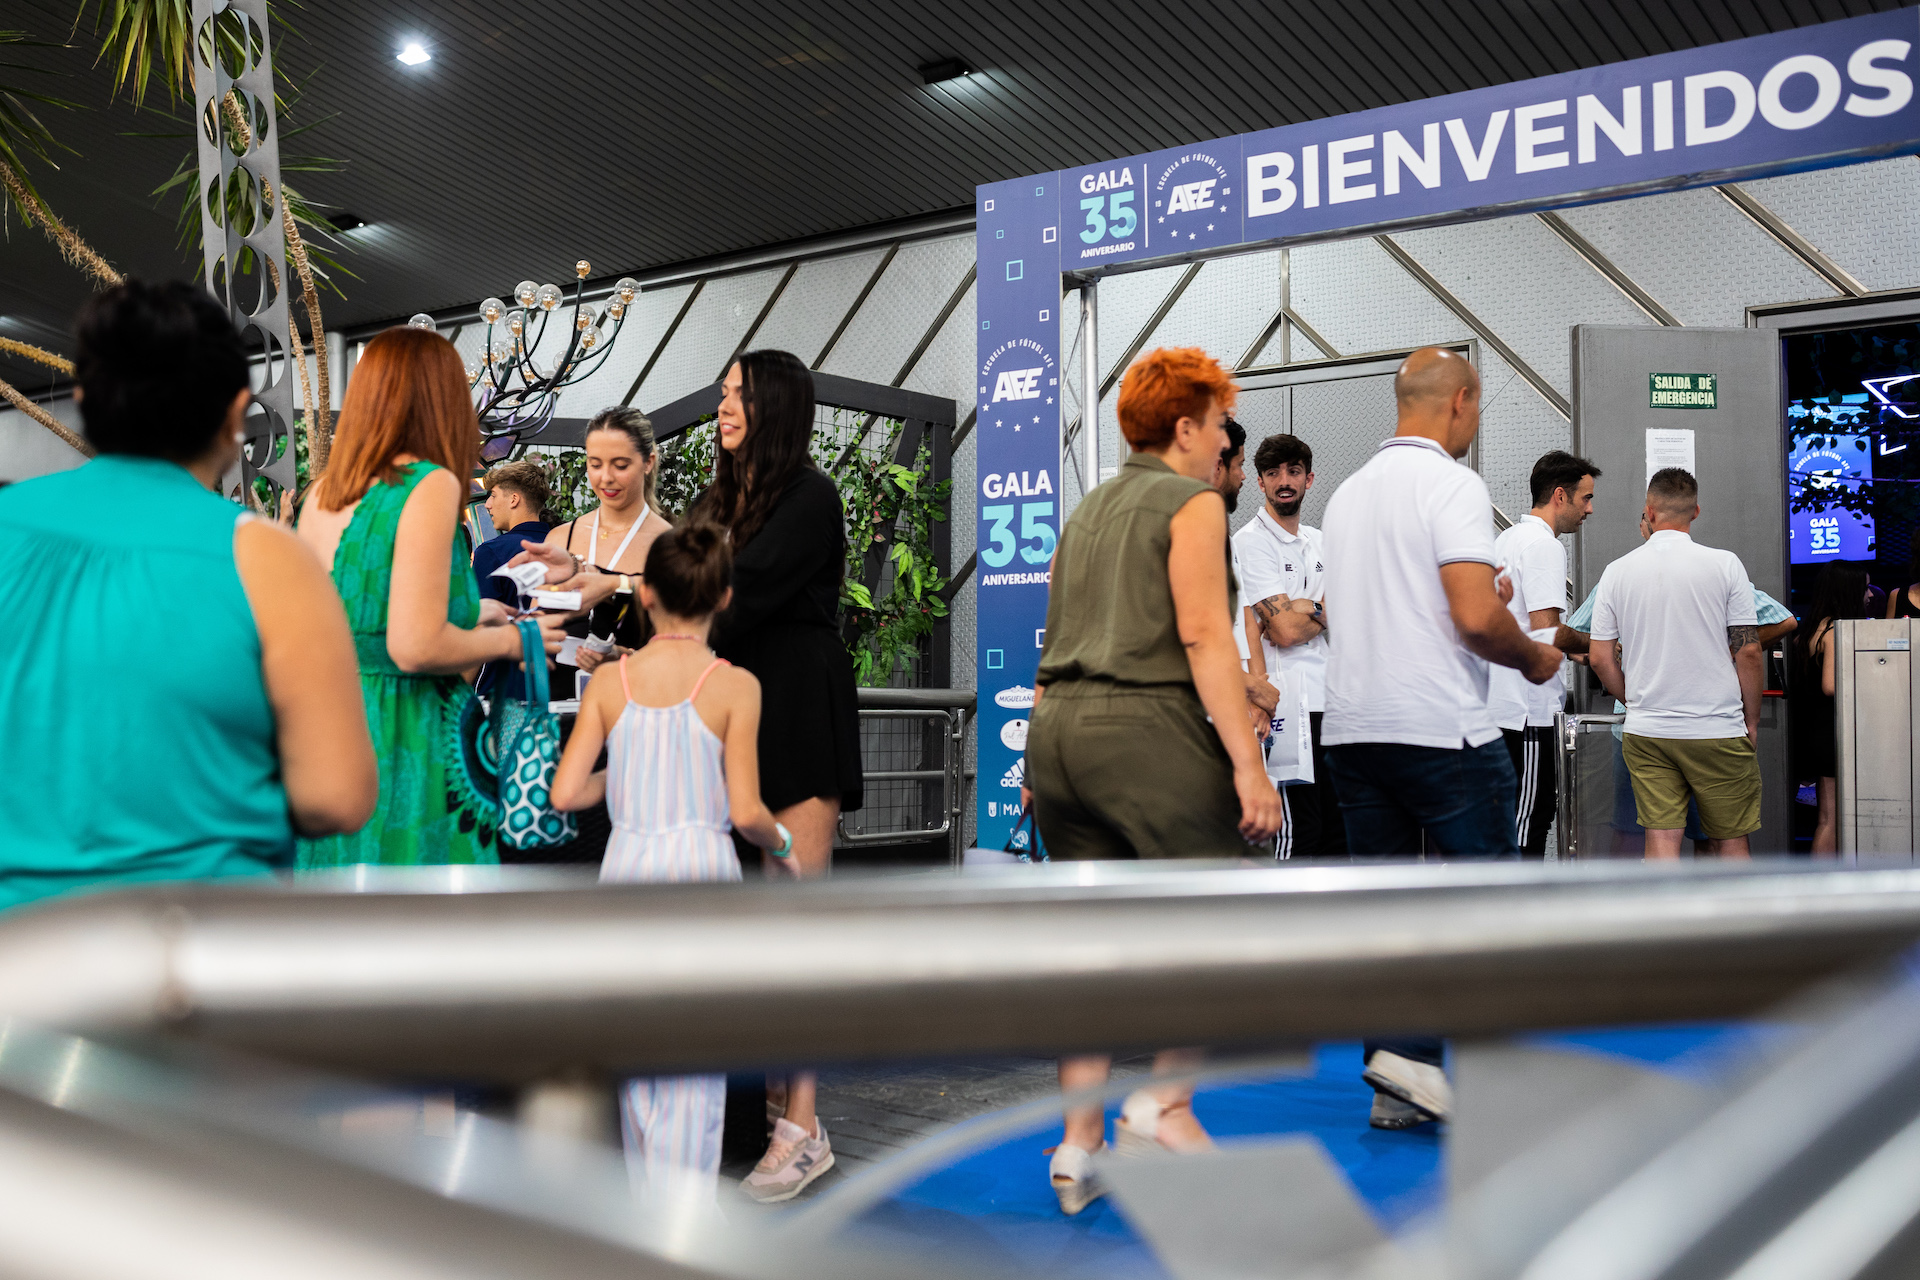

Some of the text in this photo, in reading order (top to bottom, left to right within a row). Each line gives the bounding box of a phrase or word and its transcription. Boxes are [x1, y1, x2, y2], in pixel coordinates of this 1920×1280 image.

[1246, 39, 1914, 218] BIENVENIDOS
[1079, 167, 1134, 194] GALA
[1156, 161, 1180, 190] ESCUELA
[1181, 155, 1190, 164] DE
[1216, 165, 1228, 180] AFE
[1167, 179, 1217, 215] AFE
[1079, 190, 1138, 244] 35
[1080, 241, 1135, 259] ANIVERSARIO
[981, 345, 1006, 376] ESCUELA
[1007, 339, 1016, 349] DE
[1042, 353, 1055, 369] AFE
[991, 367, 1044, 403] AFE
[1654, 376, 1712, 390] SALIDA DE
[1652, 391, 1715, 405] EMERGENCIA
[982, 469, 1053, 499] GALA
[980, 501, 1057, 568] 35
[1809, 517, 1839, 528] GALA
[1810, 527, 1841, 549] 35
[982, 571, 1051, 587] ANIVERSARIO
[999, 693, 1036, 703] MIGUELAÑE
[1270, 717, 1286, 732] FE
